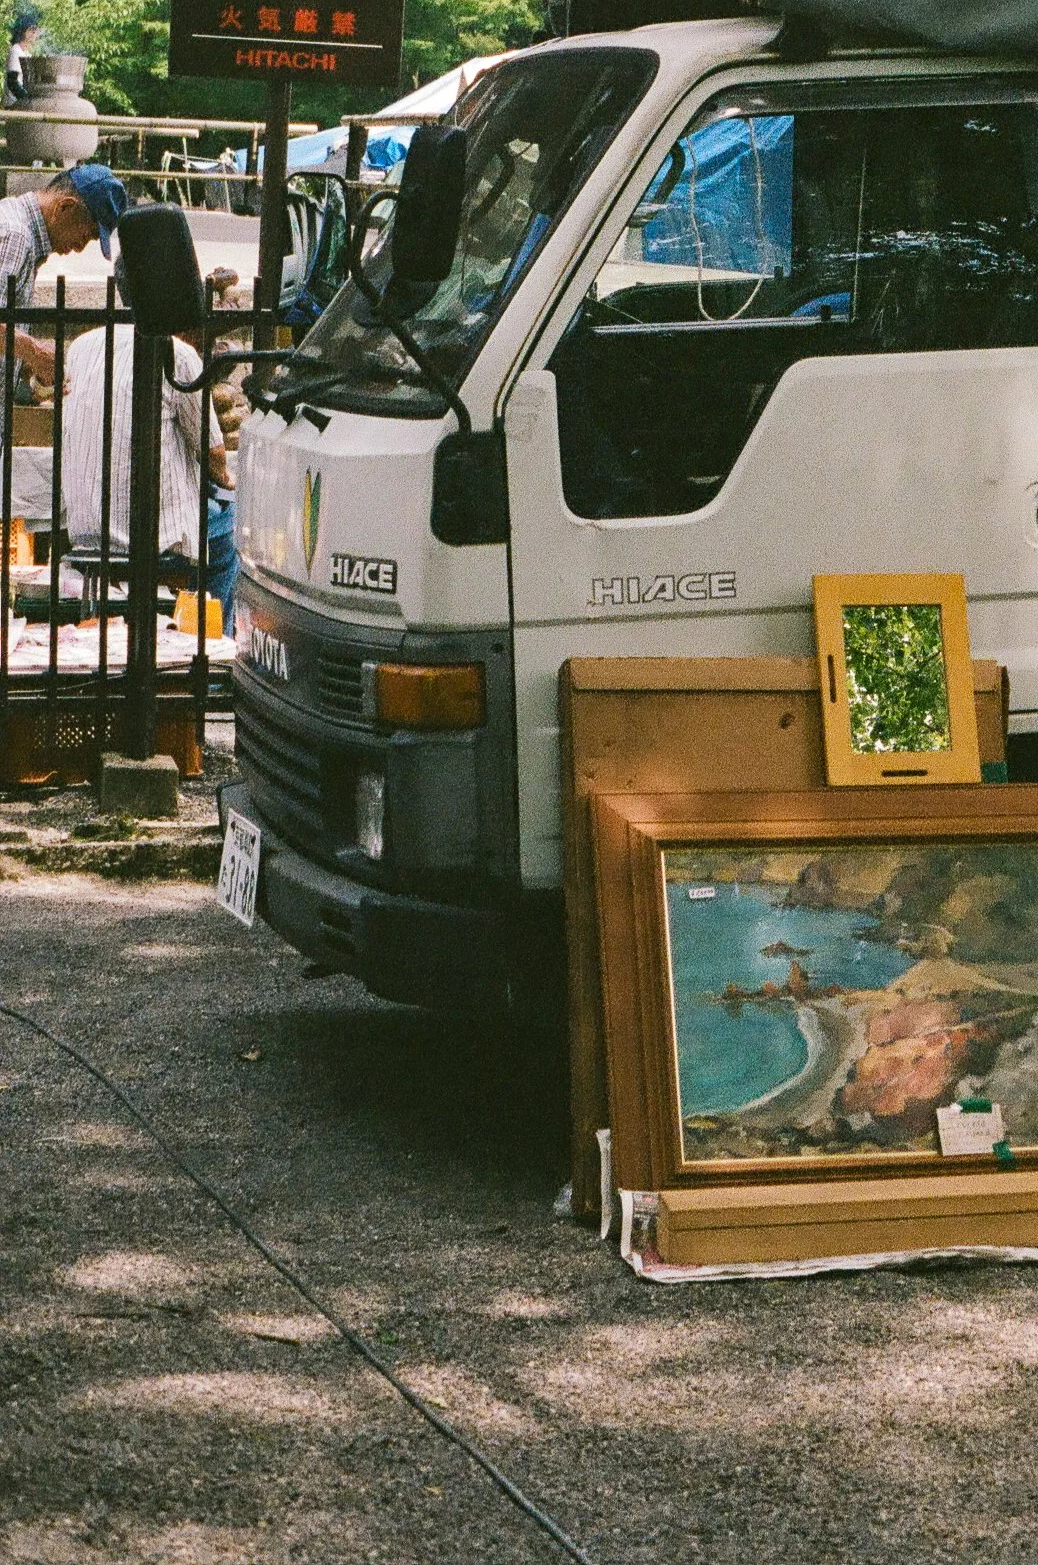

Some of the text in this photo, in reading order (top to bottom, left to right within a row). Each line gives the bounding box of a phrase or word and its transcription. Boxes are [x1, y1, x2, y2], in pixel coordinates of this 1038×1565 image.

[219, 5, 356, 35] 火気厳禁
[236, 50, 336, 70] HITACHI
[330, 556, 394, 590] HIACE
[591, 571, 736, 606] HIACE
